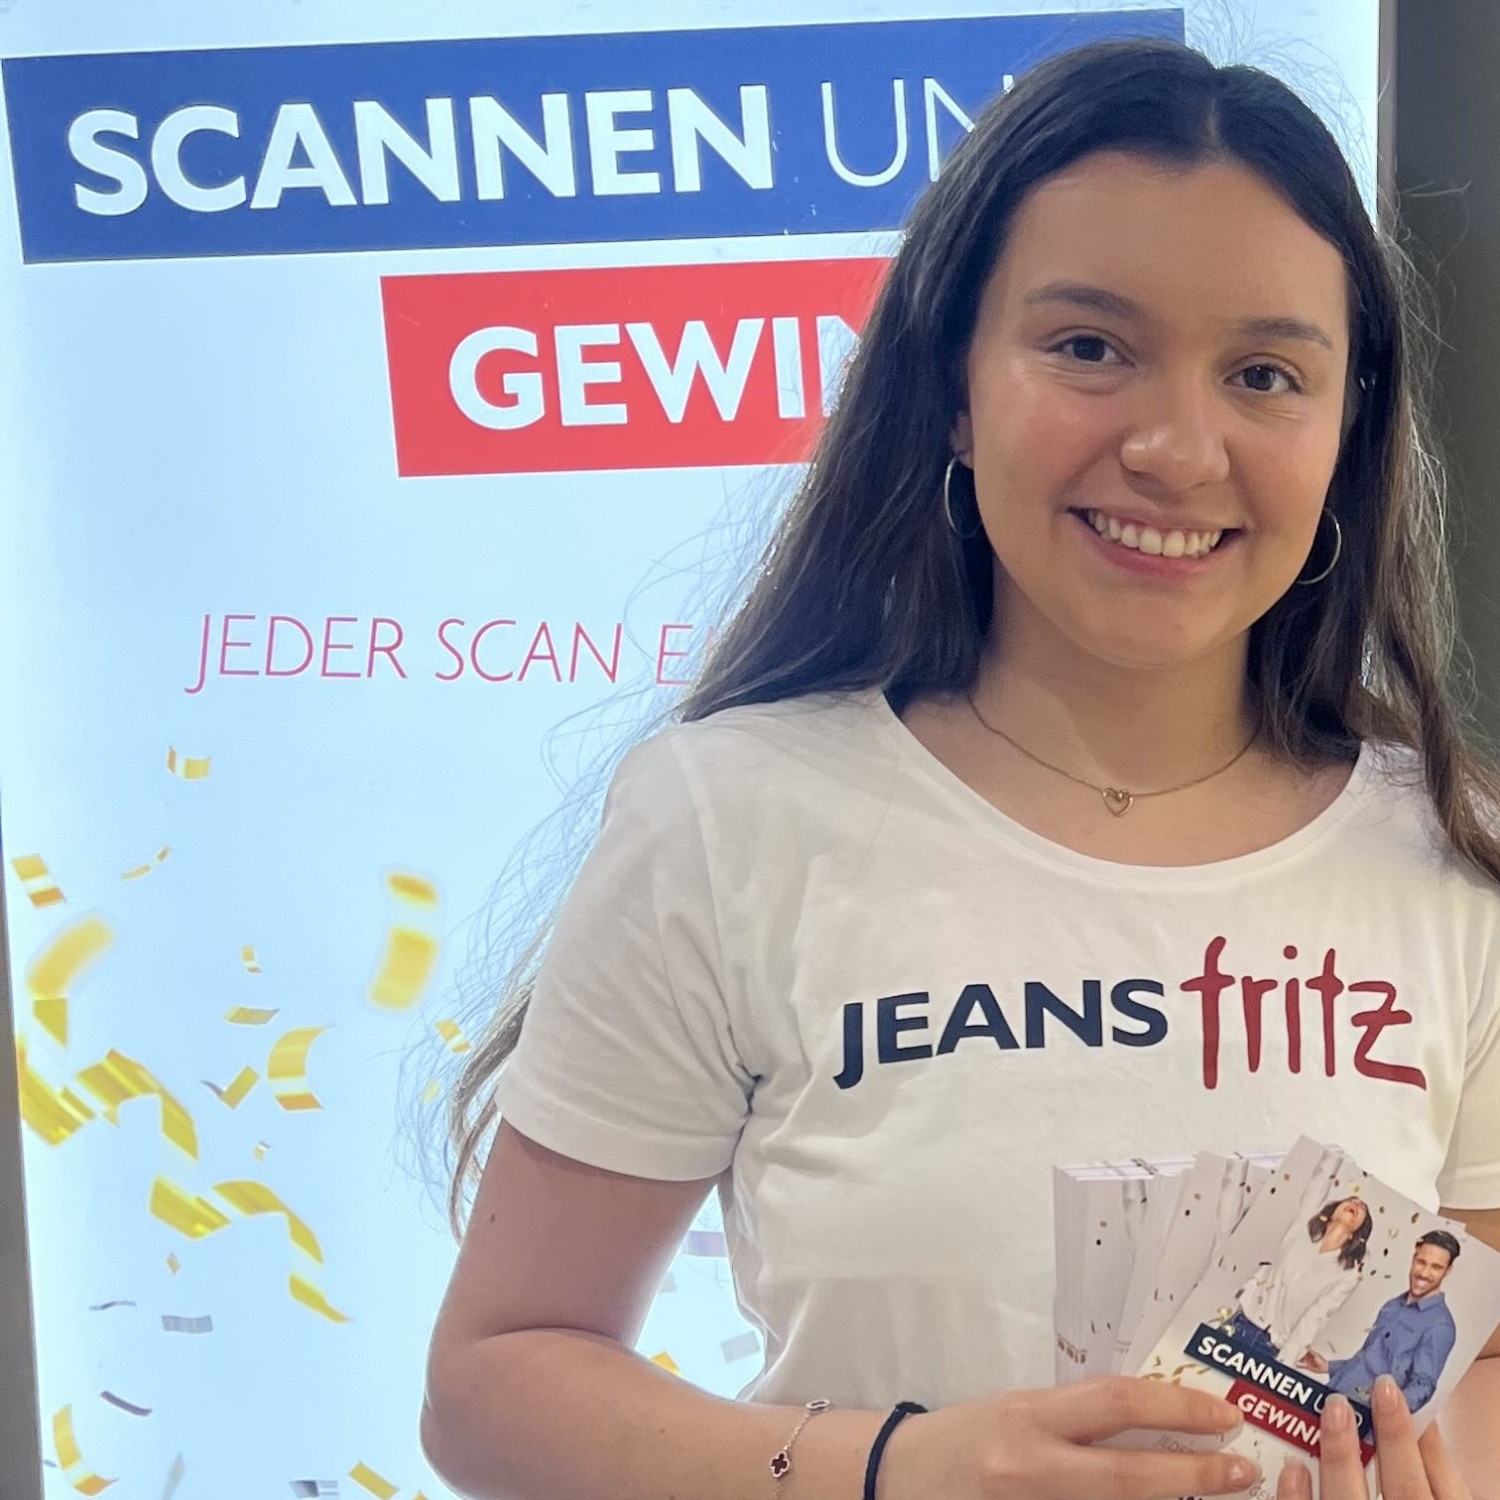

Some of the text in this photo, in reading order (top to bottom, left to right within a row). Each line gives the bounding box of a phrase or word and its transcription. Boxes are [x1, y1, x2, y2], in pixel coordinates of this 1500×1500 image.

[66, 84, 774, 216] SCANNEN
[184, 614, 407, 694] JEDER
[434, 618, 623, 685] SCAN
[832, 935, 1427, 1091] JEANS fritz
[1197, 1336, 1314, 1406] SCANNEN
